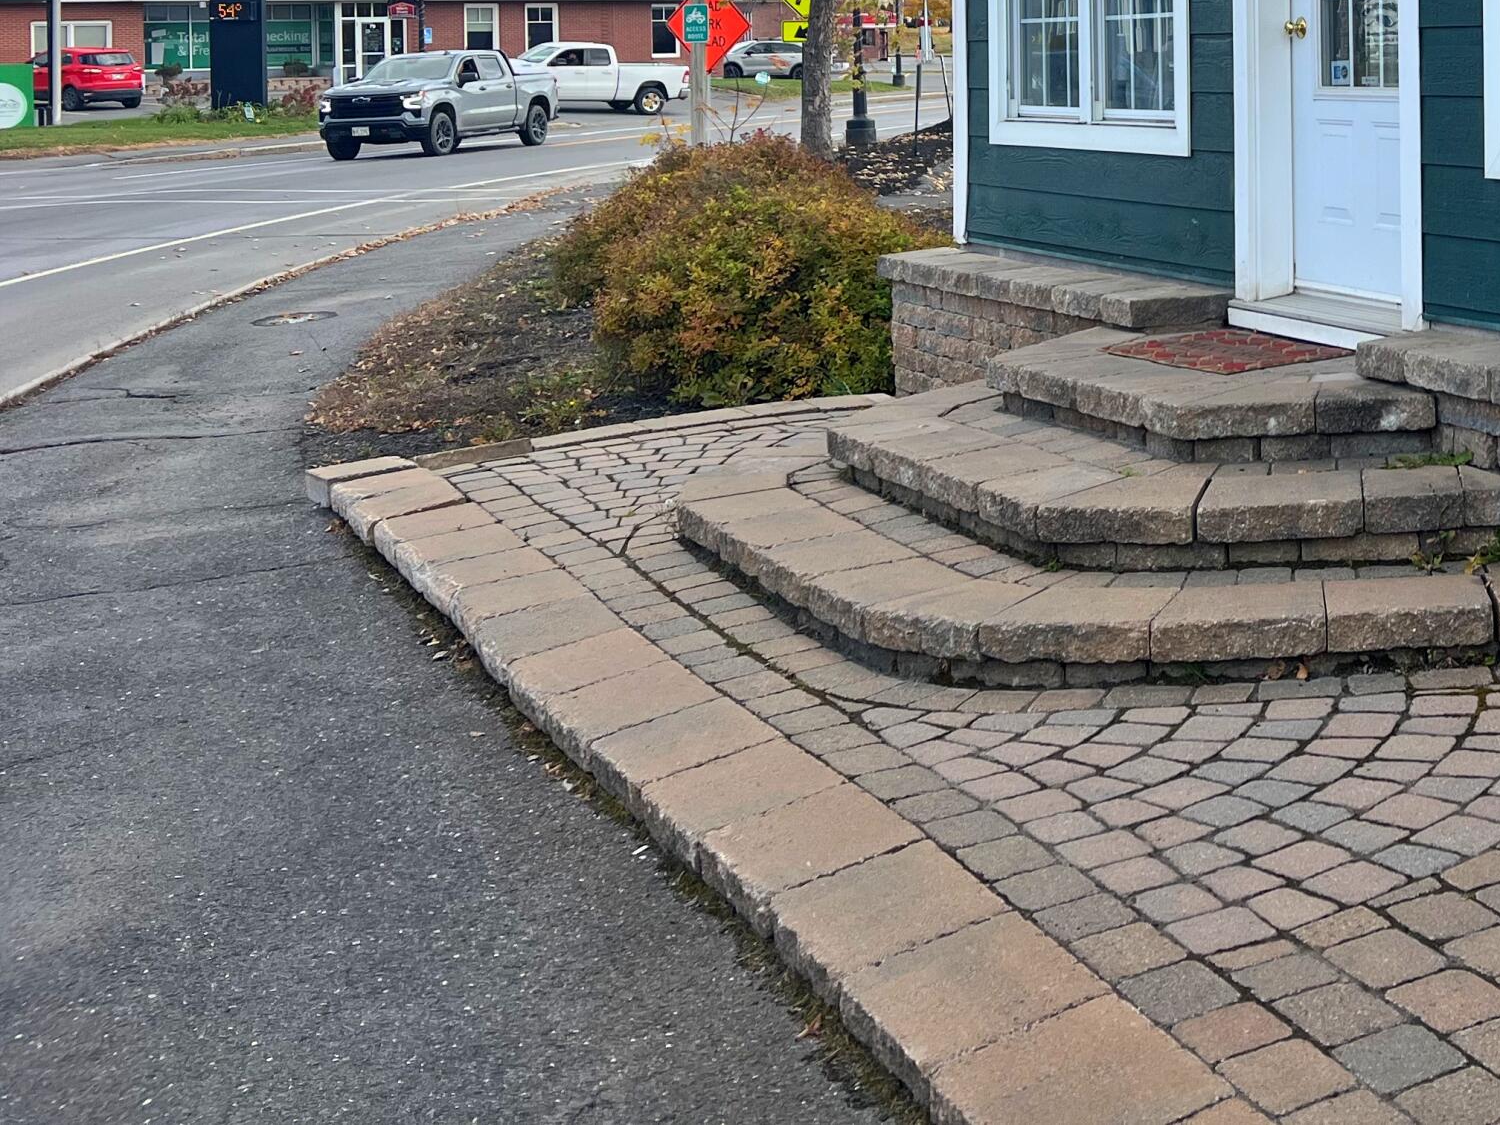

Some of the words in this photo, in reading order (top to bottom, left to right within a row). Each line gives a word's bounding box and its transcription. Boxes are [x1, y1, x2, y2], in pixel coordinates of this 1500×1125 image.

[708, 0, 721, 11] AD
[708, 18, 722, 30] RK
[177, 45, 187, 56] &
[192, 45, 210, 56] Fre
